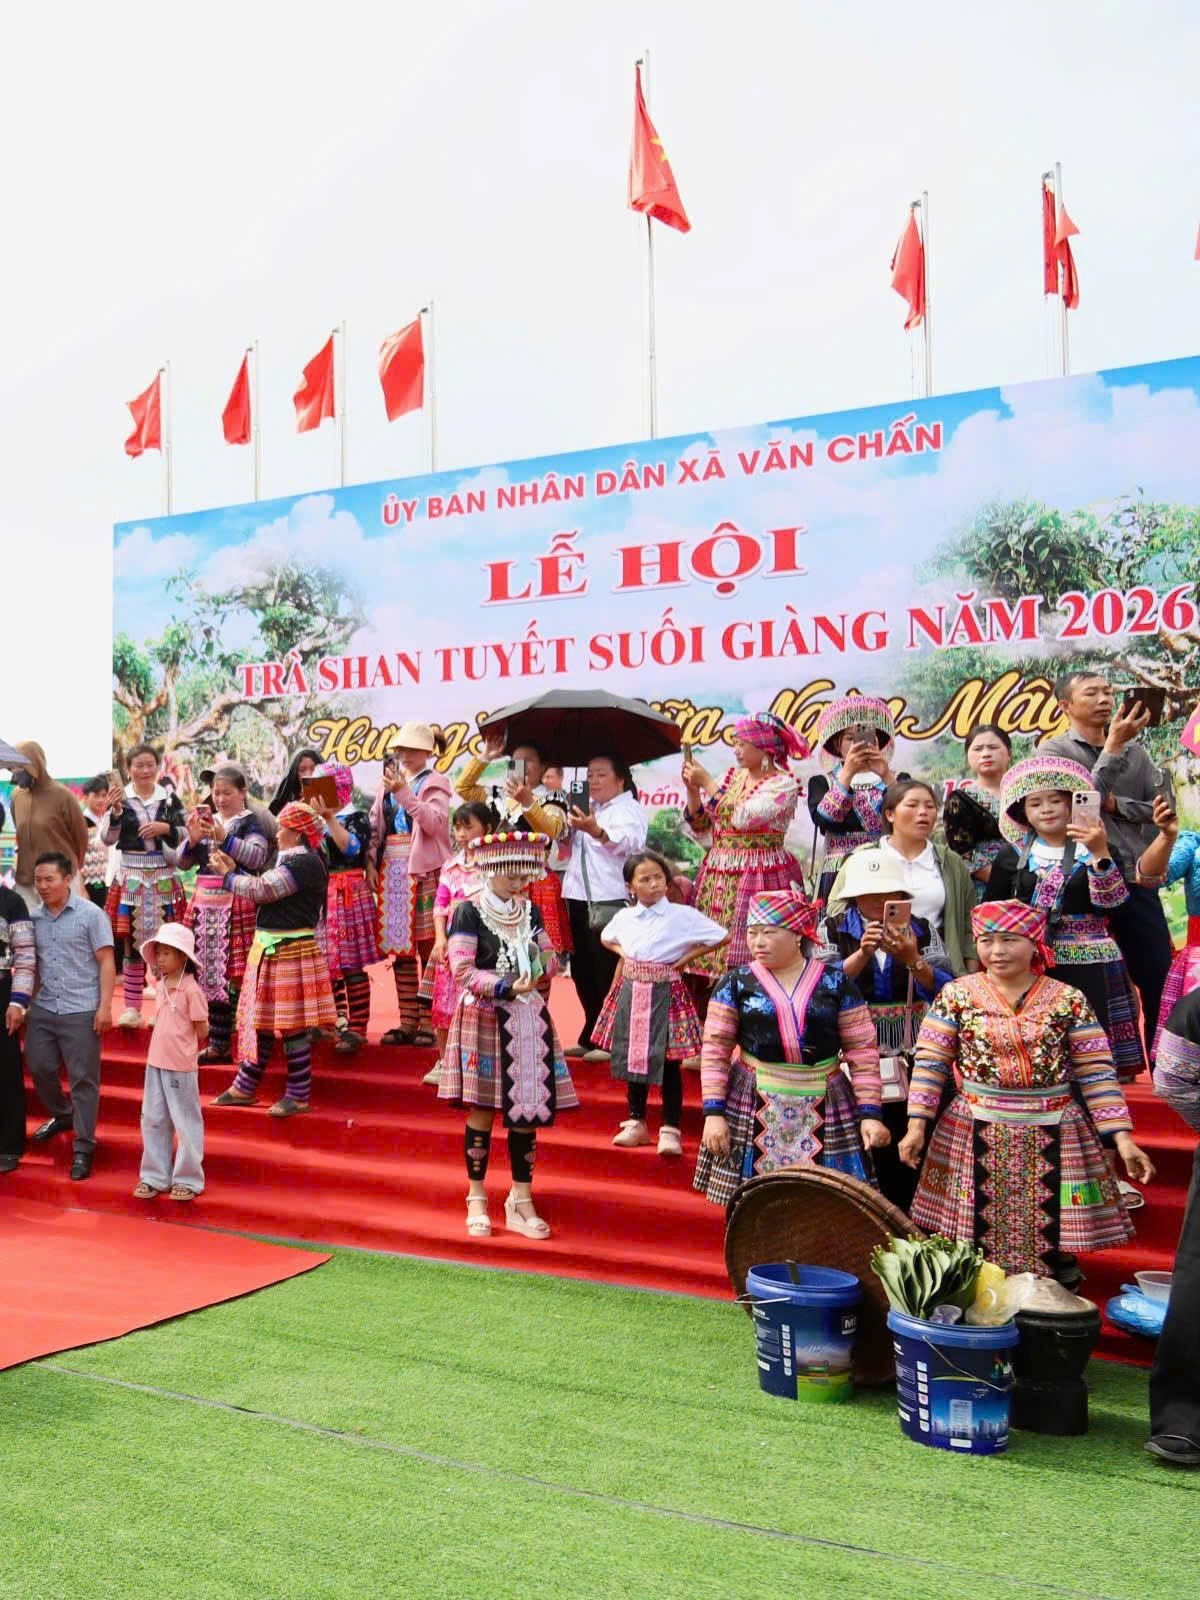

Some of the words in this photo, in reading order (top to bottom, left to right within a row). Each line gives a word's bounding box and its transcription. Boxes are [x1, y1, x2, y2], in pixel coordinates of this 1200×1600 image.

[382, 494, 418, 526] ỦY
[427, 489, 486, 519] BAN
[496, 473, 585, 509] NHÂN
[596, 461, 666, 496] DÂN
[677, 449, 726, 485] XÃ
[737, 439, 814, 476] VĂN
[827, 415, 942, 464] CHẤN
[483, 529, 588, 605] LỄ
[614, 521, 806, 594] HỘI
[237, 649, 311, 699] TRÀ
[317, 650, 423, 693] SHAN
[434, 619, 576, 684] TUYẾT
[588, 607, 706, 672] SUỐI
[720, 604, 890, 662] GIÀNG
[905, 591, 1041, 648] NĂM
[1058, 584, 1196, 638] 2026
[637, 784, 687, 809] hấn,
